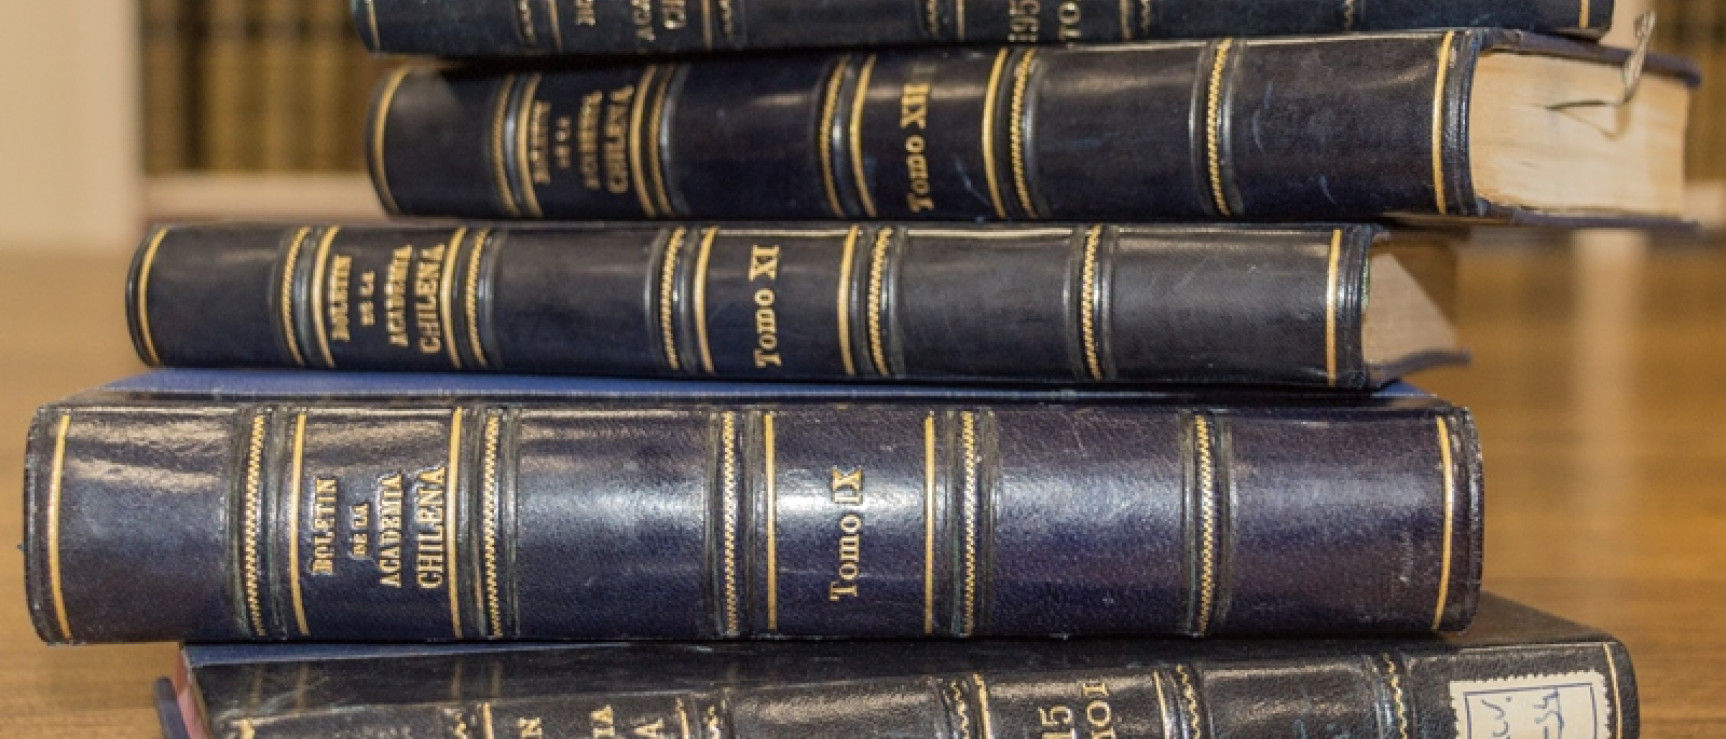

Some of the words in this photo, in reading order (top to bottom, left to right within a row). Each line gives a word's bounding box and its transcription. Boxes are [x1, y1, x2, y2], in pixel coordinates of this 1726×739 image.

[604, 84, 634, 194] CHILENA
[900, 82, 931, 130] XII
[329, 254, 352, 342] BOLETIN
[384, 244, 412, 347] ACADEMIA
[414, 243, 445, 354] CHILENA
[748, 244, 781, 282] XI
[754, 287, 782, 368] Tomo
[312, 477, 337, 574] BOLETIN
[353, 503, 370, 528] LA
[416, 465, 446, 589] CHILENA
[832, 464, 864, 505] IX
[353, 533, 368, 556] DE
[379, 472, 403, 589] ACADEMIA
[828, 514, 862, 602] Tomo
